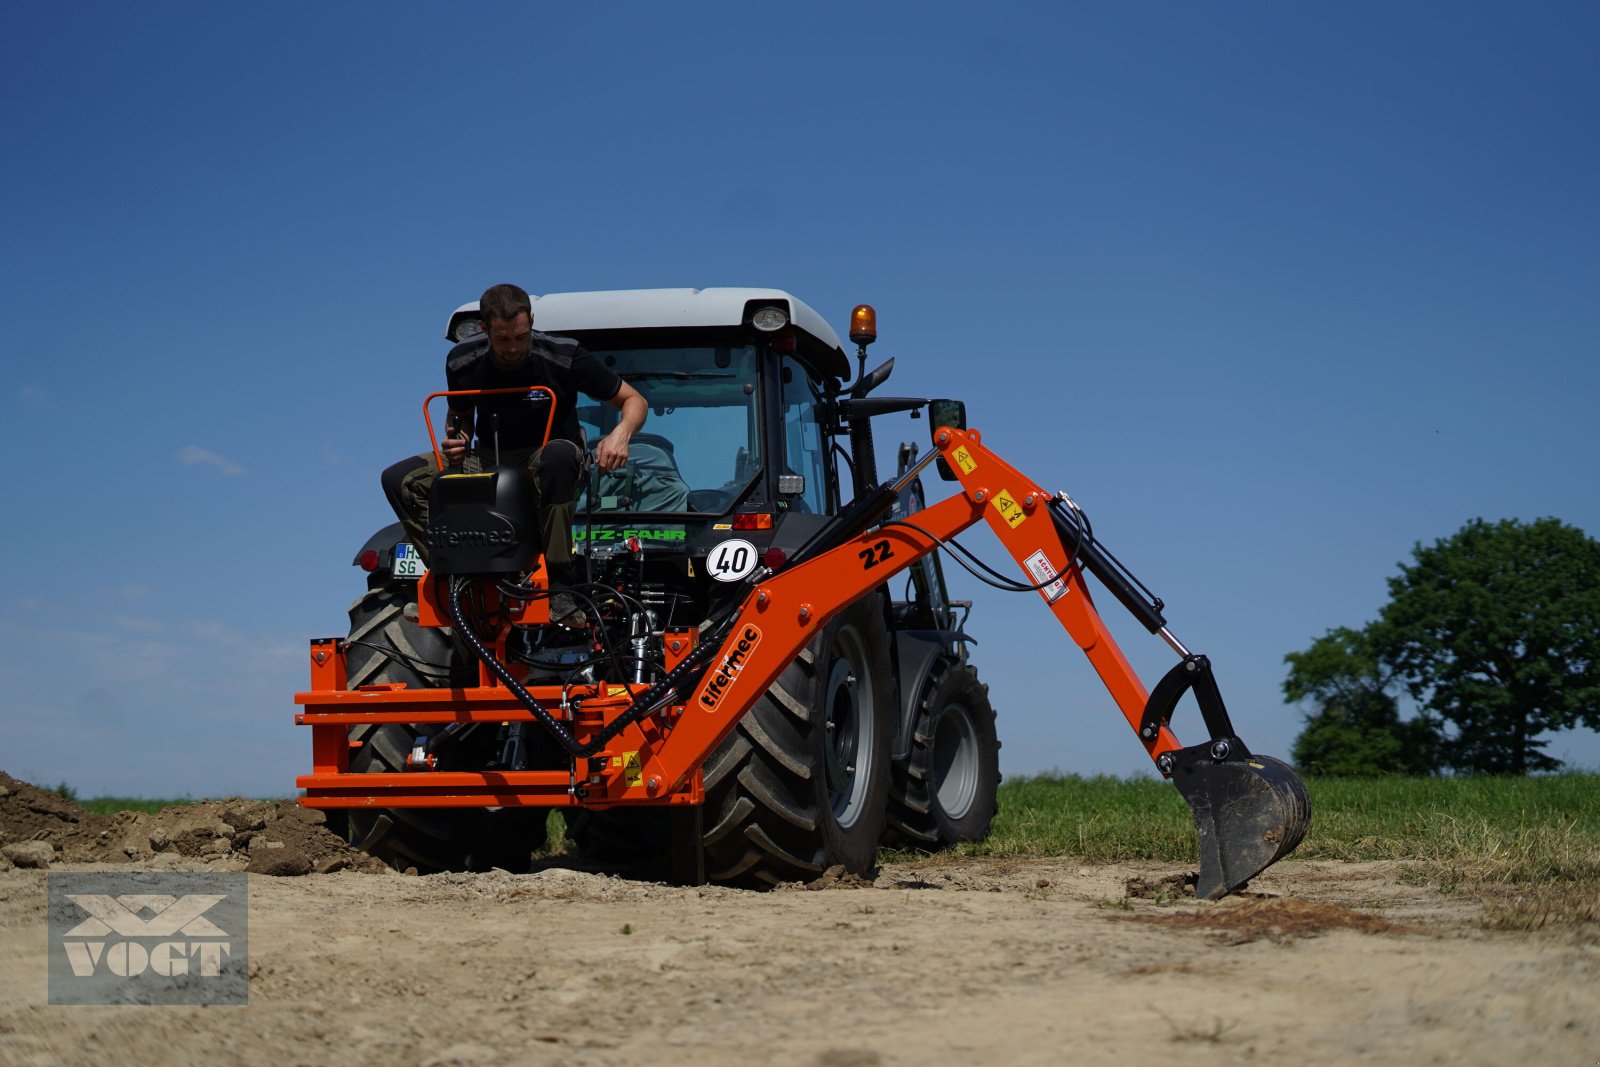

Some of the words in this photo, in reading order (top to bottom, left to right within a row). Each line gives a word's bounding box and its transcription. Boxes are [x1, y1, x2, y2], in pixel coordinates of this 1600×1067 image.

[426, 525, 512, 547] tifermec
[571, 529, 687, 541] UTZ-FAHR
[406, 545, 421, 560] H
[715, 547, 748, 574] 40
[858, 540, 895, 570] 22
[398, 560, 416, 574] SG
[1037, 558, 1062, 590] ACHTUG!
[701, 628, 758, 707] tifermec
